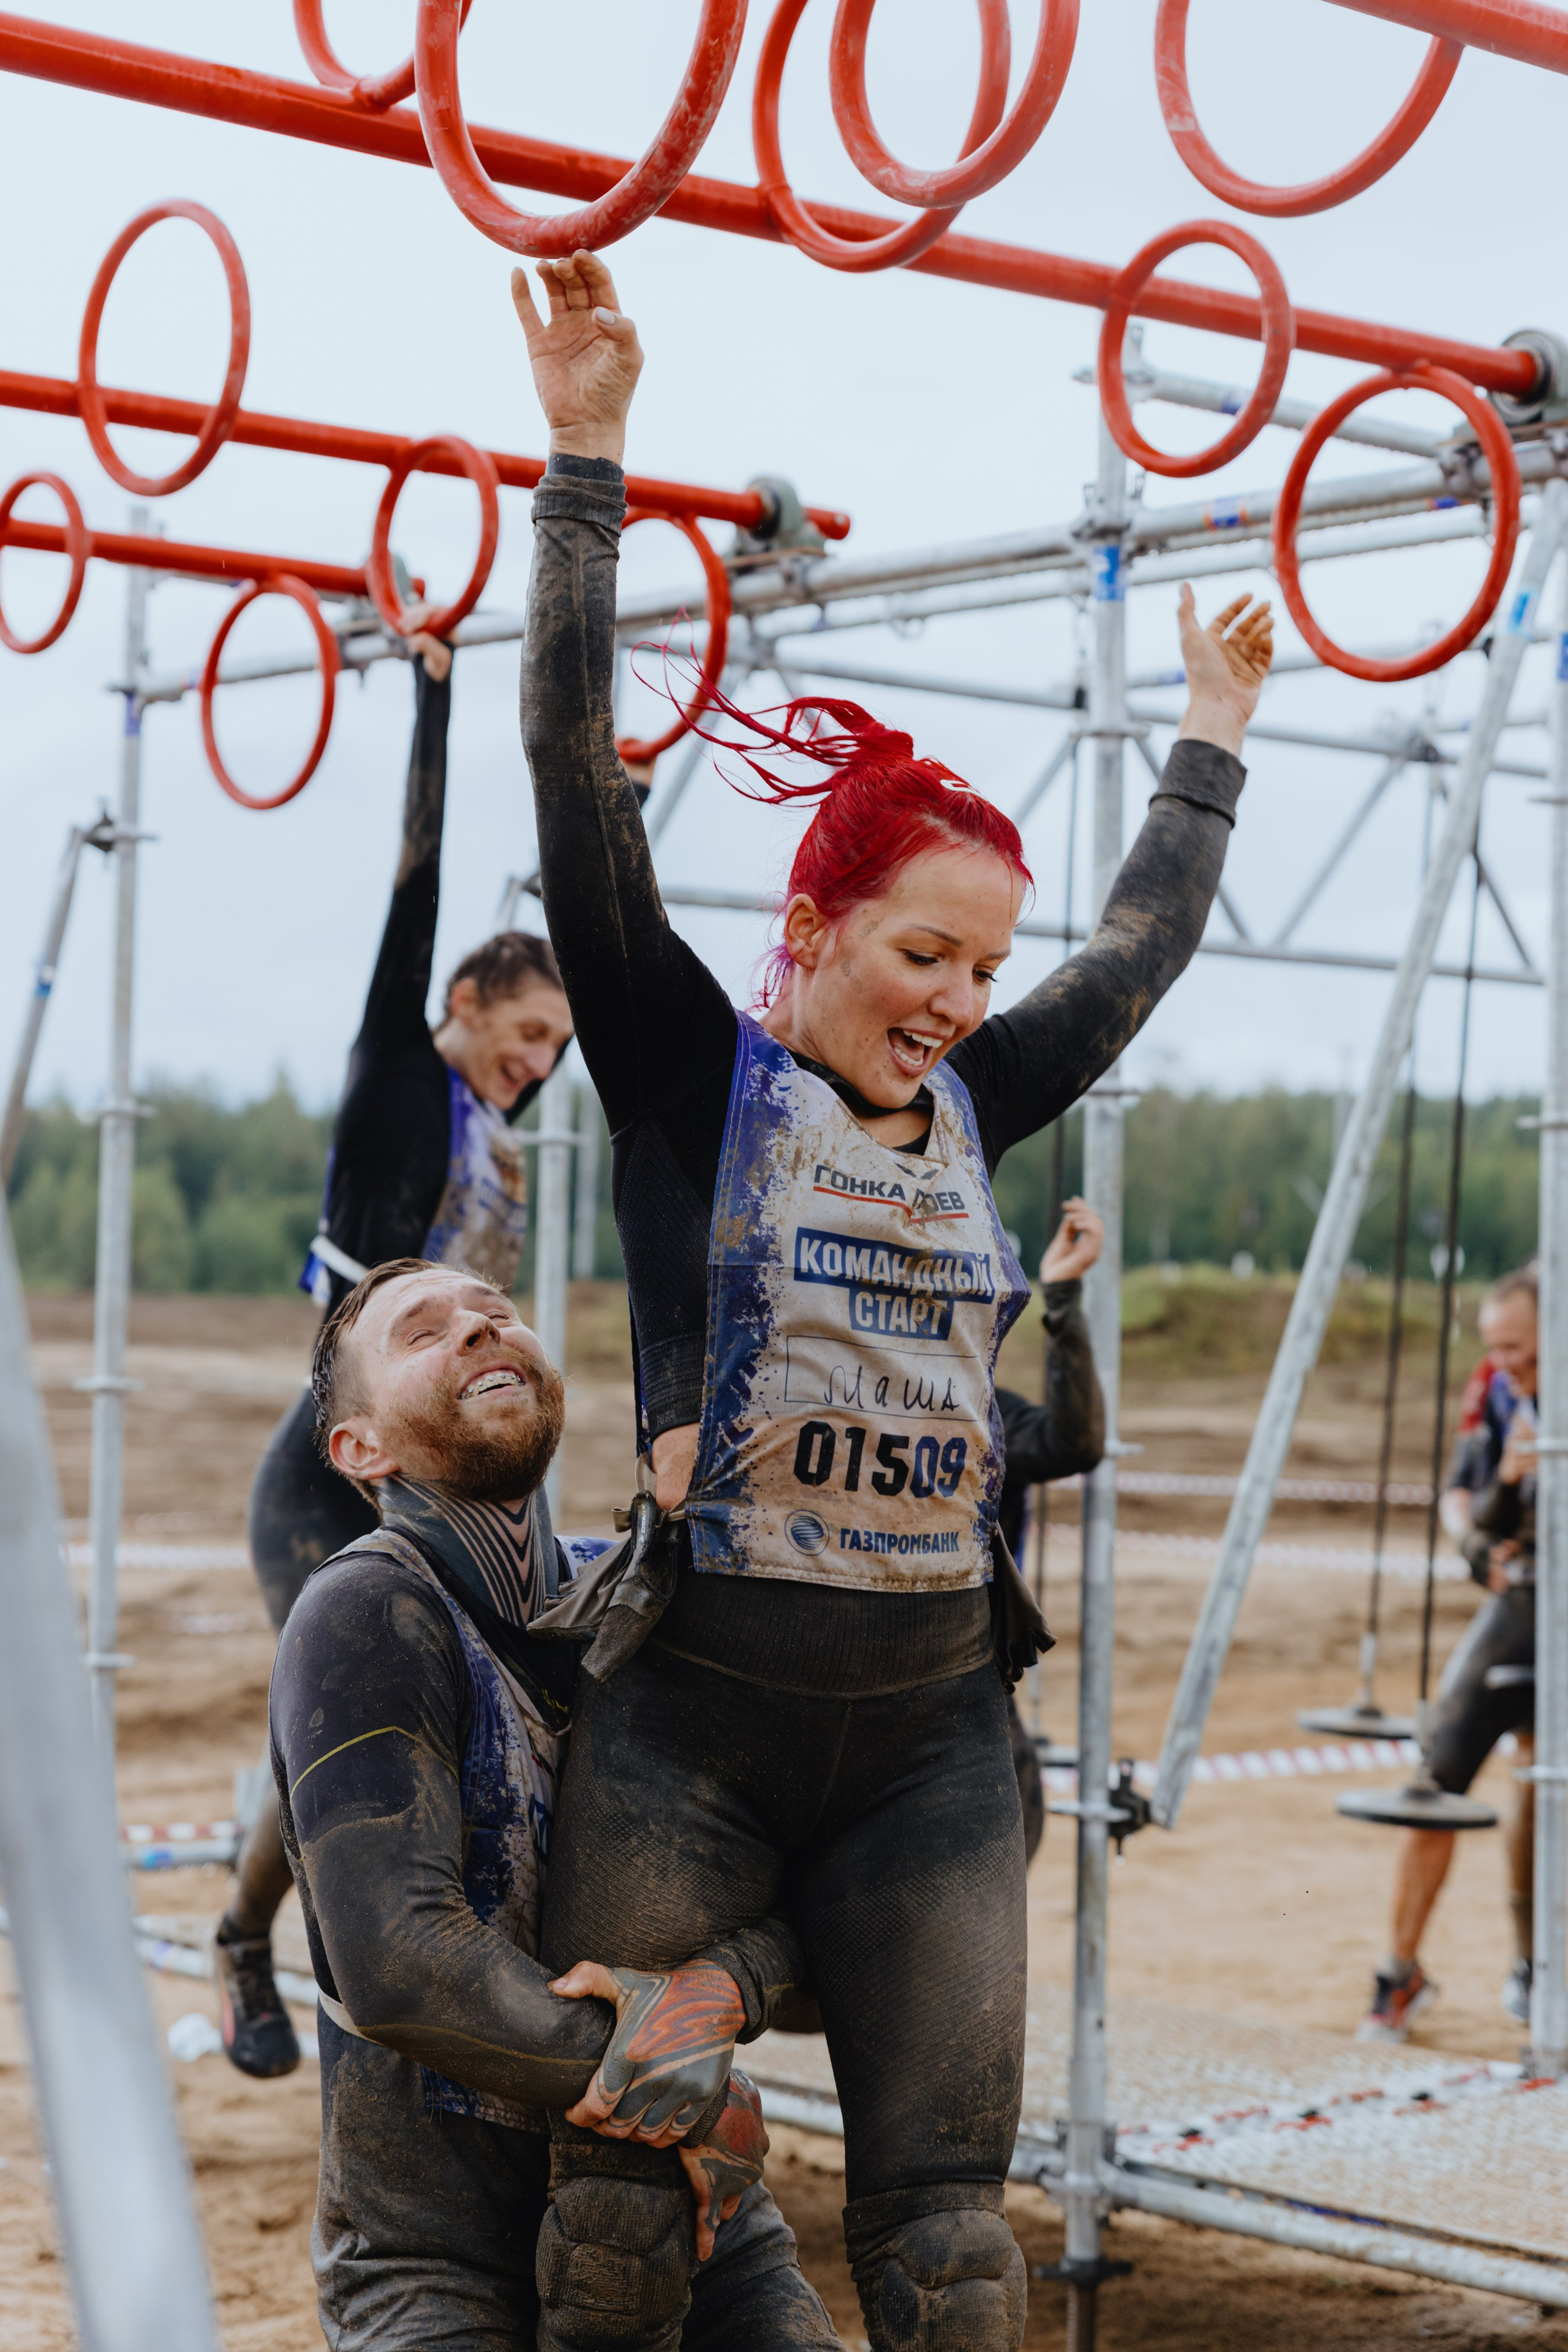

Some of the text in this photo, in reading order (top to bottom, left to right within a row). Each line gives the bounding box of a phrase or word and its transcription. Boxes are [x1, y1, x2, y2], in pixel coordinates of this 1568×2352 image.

[814, 1164, 906, 1201] ГОНКА
[800, 1237, 992, 1296] КОМАНДНЫЙ
[855, 1292, 947, 1335] СТАРТ
[793, 1421, 968, 1498] 01509
[840, 1528, 960, 1555] ГАЗПРОМБАНК
